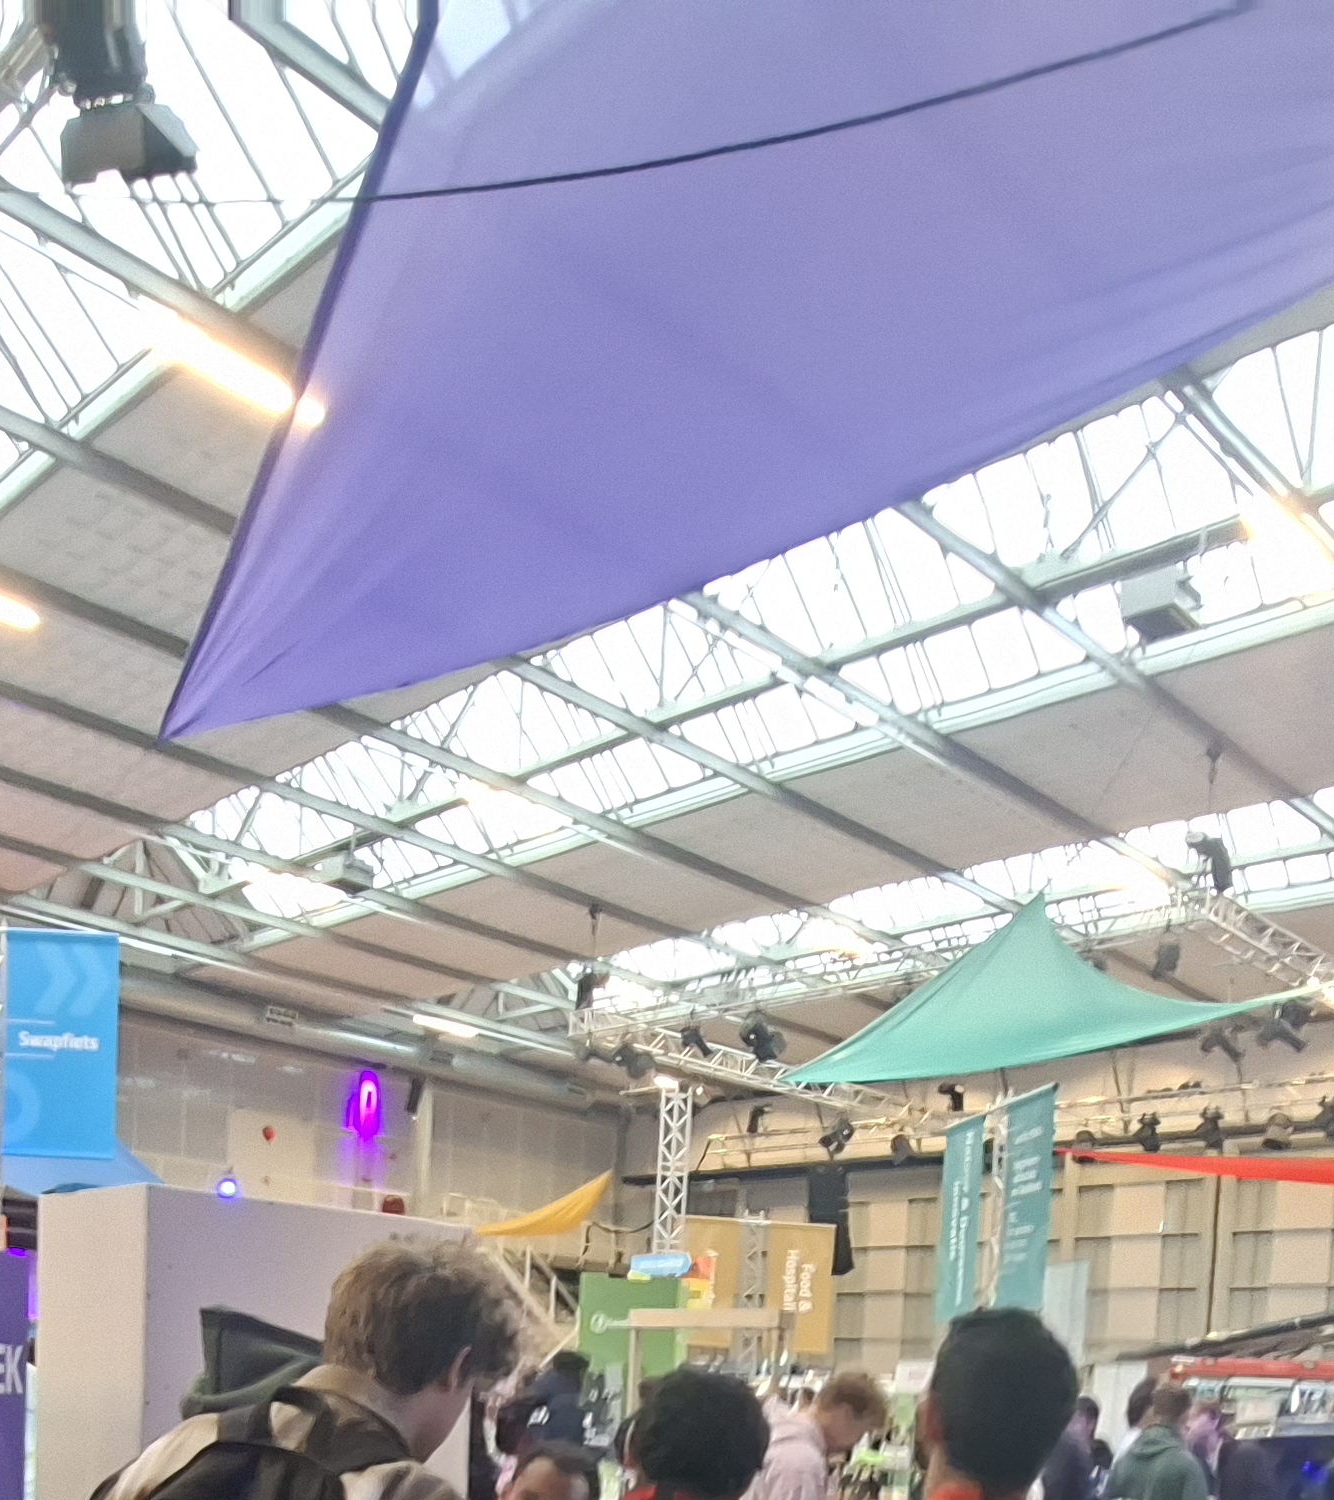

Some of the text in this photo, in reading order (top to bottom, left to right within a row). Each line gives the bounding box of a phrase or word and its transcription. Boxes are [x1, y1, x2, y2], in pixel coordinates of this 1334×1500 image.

[782, 1249, 799, 1311] Hospitali
[798, 1265, 817, 1313] Food &
